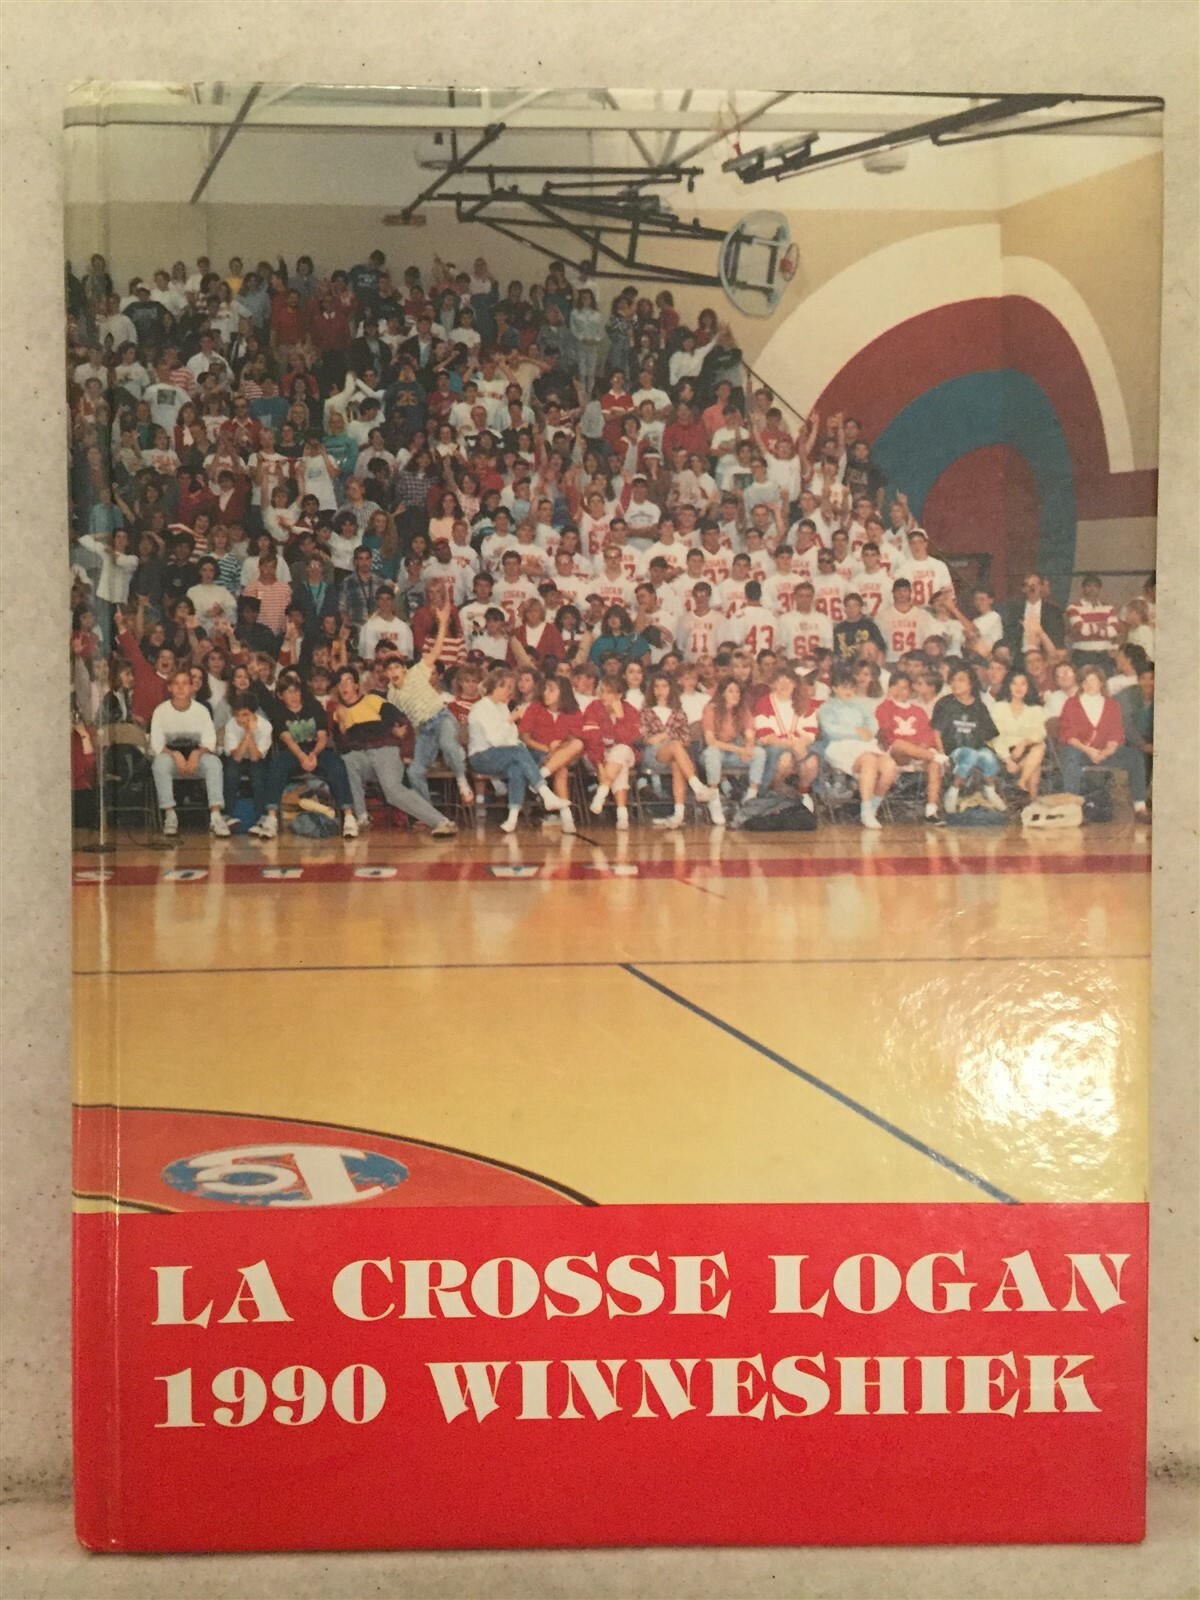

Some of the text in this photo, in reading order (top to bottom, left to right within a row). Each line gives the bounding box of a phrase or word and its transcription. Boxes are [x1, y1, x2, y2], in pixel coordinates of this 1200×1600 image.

[504, 590, 526, 599] LOGAN
[912, 580, 934, 605] 81
[815, 598, 843, 621] 96
[690, 633, 709, 653] 11
[745, 625, 773, 655] 43
[892, 631, 917, 651] 64
[150, 1249, 1132, 1330] LA CROSSE LOGAN
[153, 1350, 1103, 1429] 1990 WINNESHIEK
